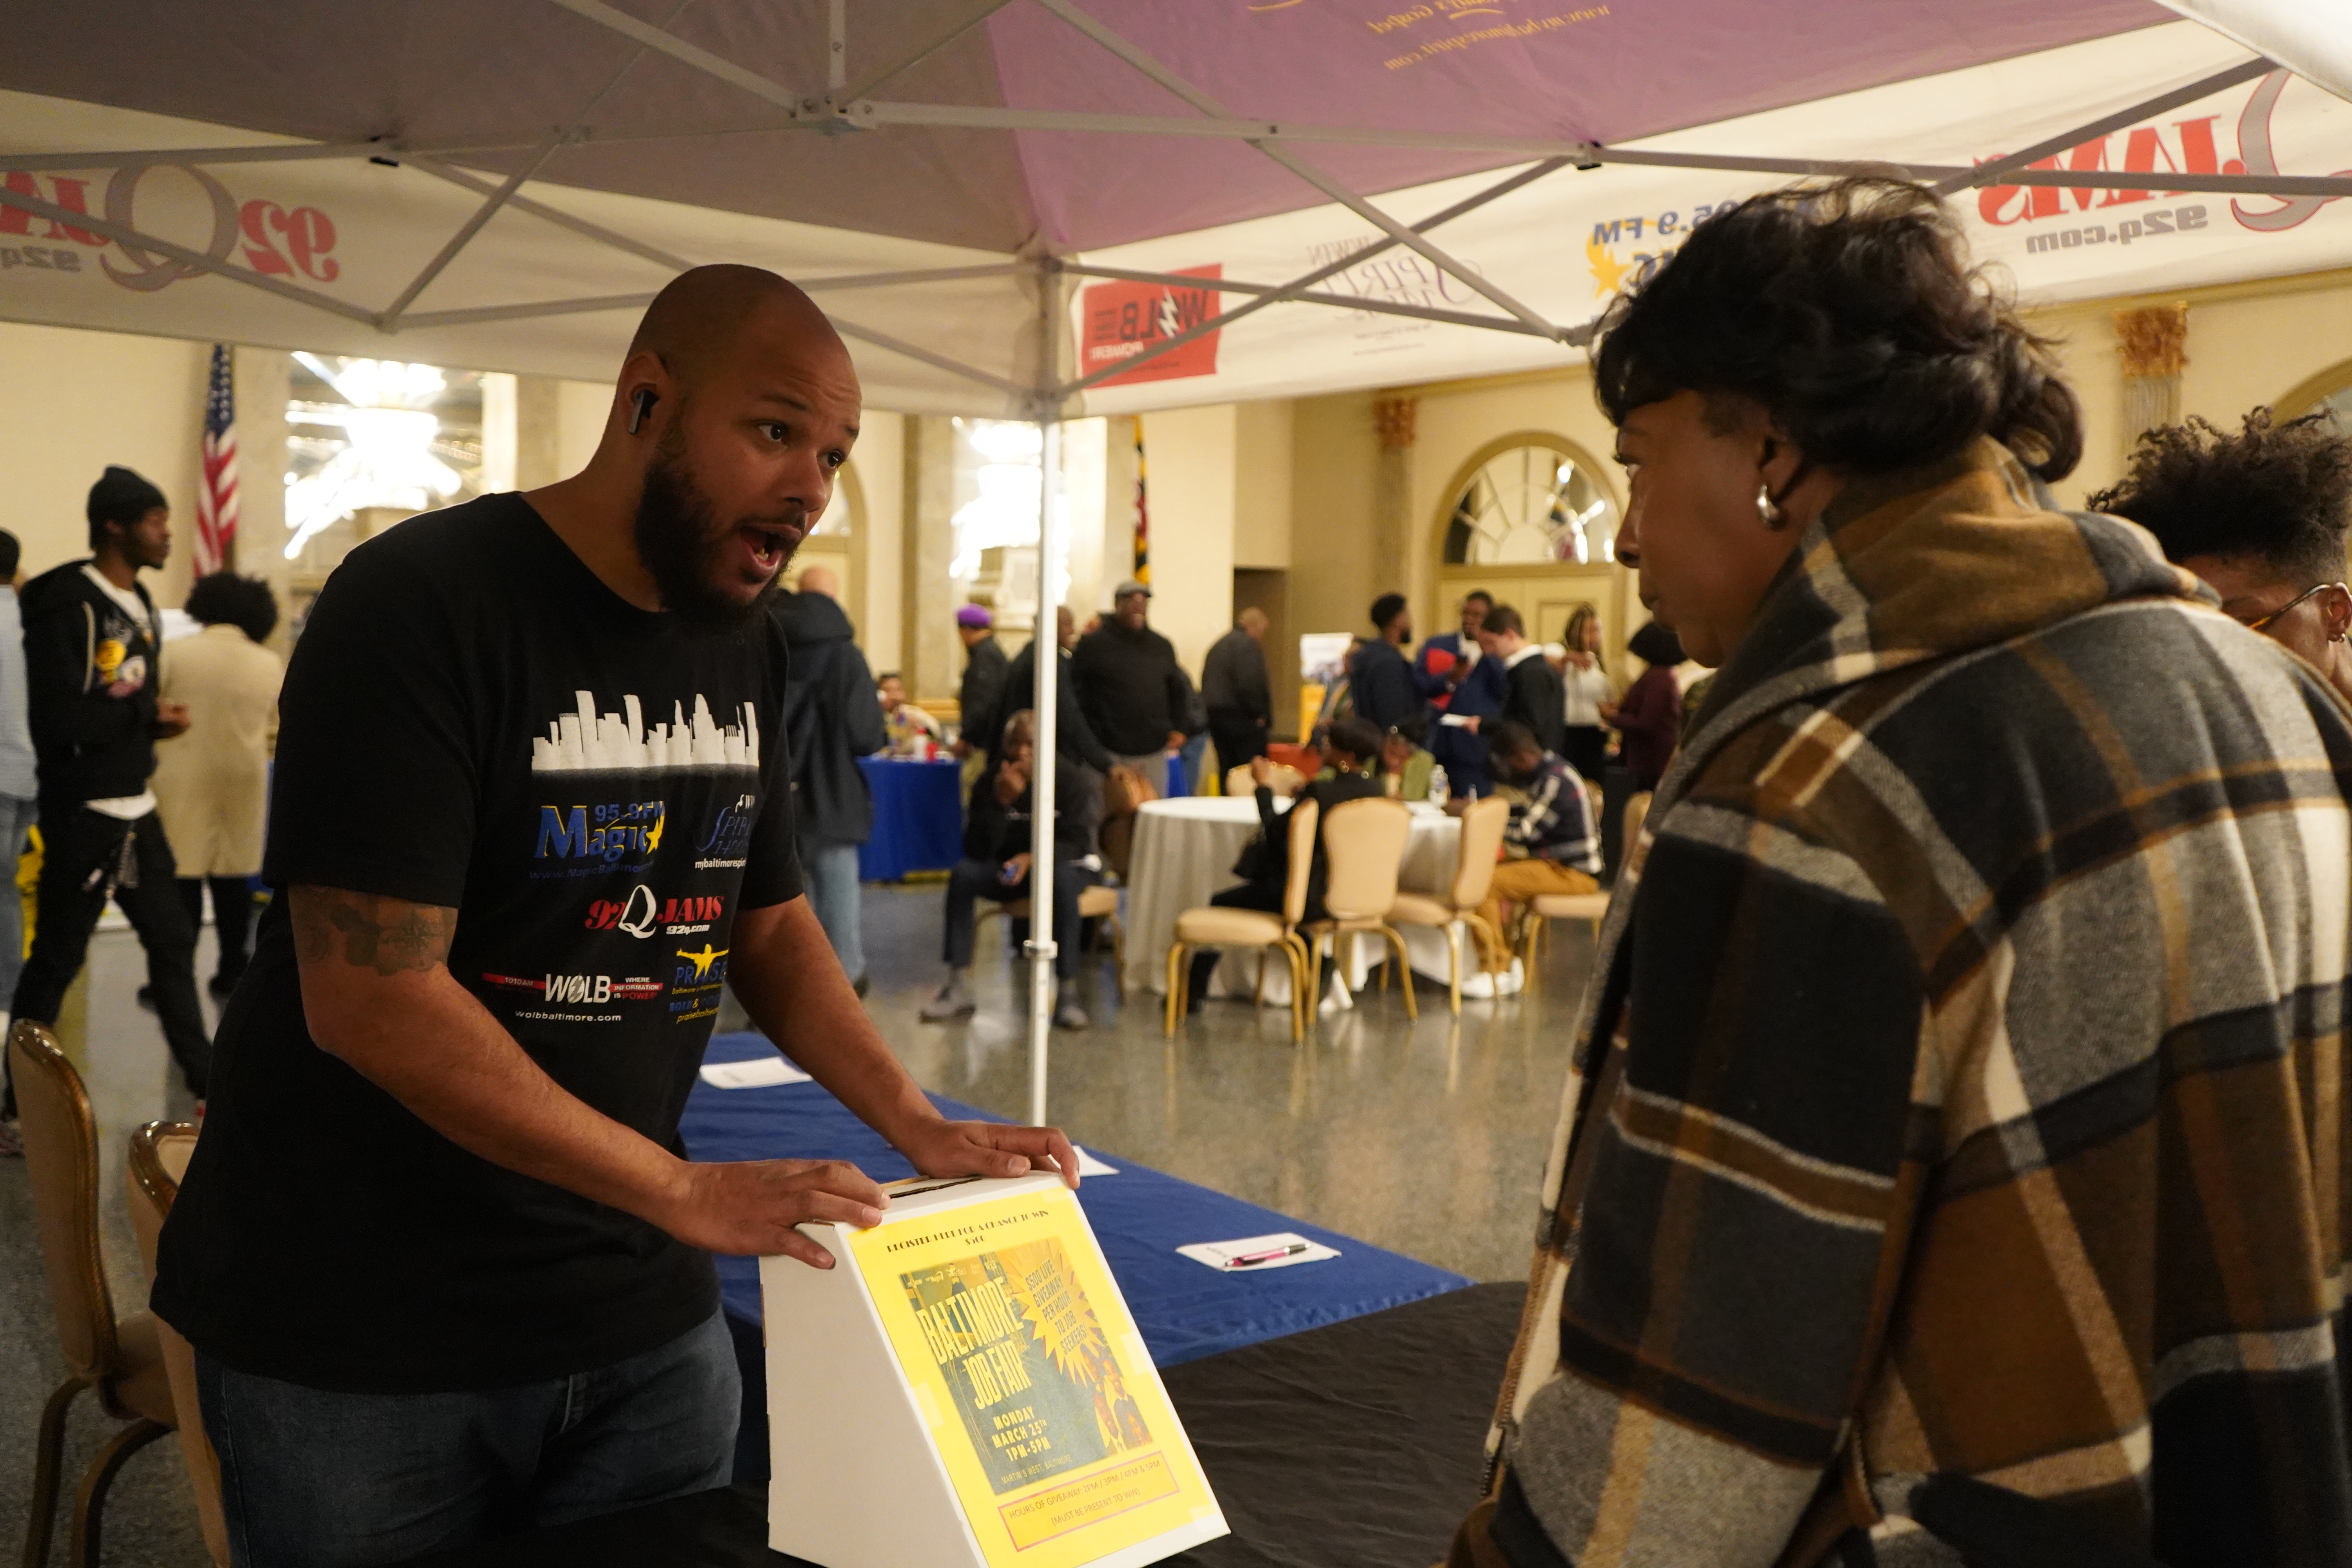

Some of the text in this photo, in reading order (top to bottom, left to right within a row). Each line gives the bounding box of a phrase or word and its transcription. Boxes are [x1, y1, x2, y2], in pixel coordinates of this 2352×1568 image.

[656, 895, 724, 924] JAMS
[544, 973, 611, 1004] WOLB
[515, 1010, 622, 1022] wolbbaltimore.com
[887, 1235, 933, 1253] REGISTER
[933, 1229, 956, 1241] HERE
[958, 1225, 976, 1236] FOR
[985, 1216, 1020, 1230] CHANCE
[1020, 1213, 1031, 1221] TO
[1031, 1210, 1049, 1219] WIN
[964, 1234, 986, 1247] $500
[1025, 1259, 1056, 1292] $500 LIVE
[1033, 1274, 1064, 1308] GIVEAWAY
[916, 1276, 1024, 1365] BALTIMORE
[1042, 1290, 1073, 1324] PER HOUR
[1054, 1309, 1077, 1336] TO JOB
[1060, 1322, 1089, 1356] SEEKERS!
[962, 1339, 1033, 1410] JOB FAIR
[993, 1405, 1035, 1430] MONDAY
[991, 1425, 1029, 1449] MARCH
[1005, 1436, 1051, 1462] 1PM-5PM
[1001, 1468, 1028, 1485] MARTIN'S
[1044, 1454, 1073, 1470] BALTIMORE
[1009, 1504, 1035, 1519] HOURS
[1035, 1500, 1045, 1510] OF
[1046, 1488, 1082, 1506] GIVEAWAY:
[1082, 1481, 1099, 1493] 2PM
[1103, 1474, 1120, 1486] 3PM
[1124, 1467, 1140, 1479] 4PM
[1145, 1459, 1161, 1472] 5PM
[1051, 1487, 1141, 1527] (MUST BE PRESENT TO WIN)
